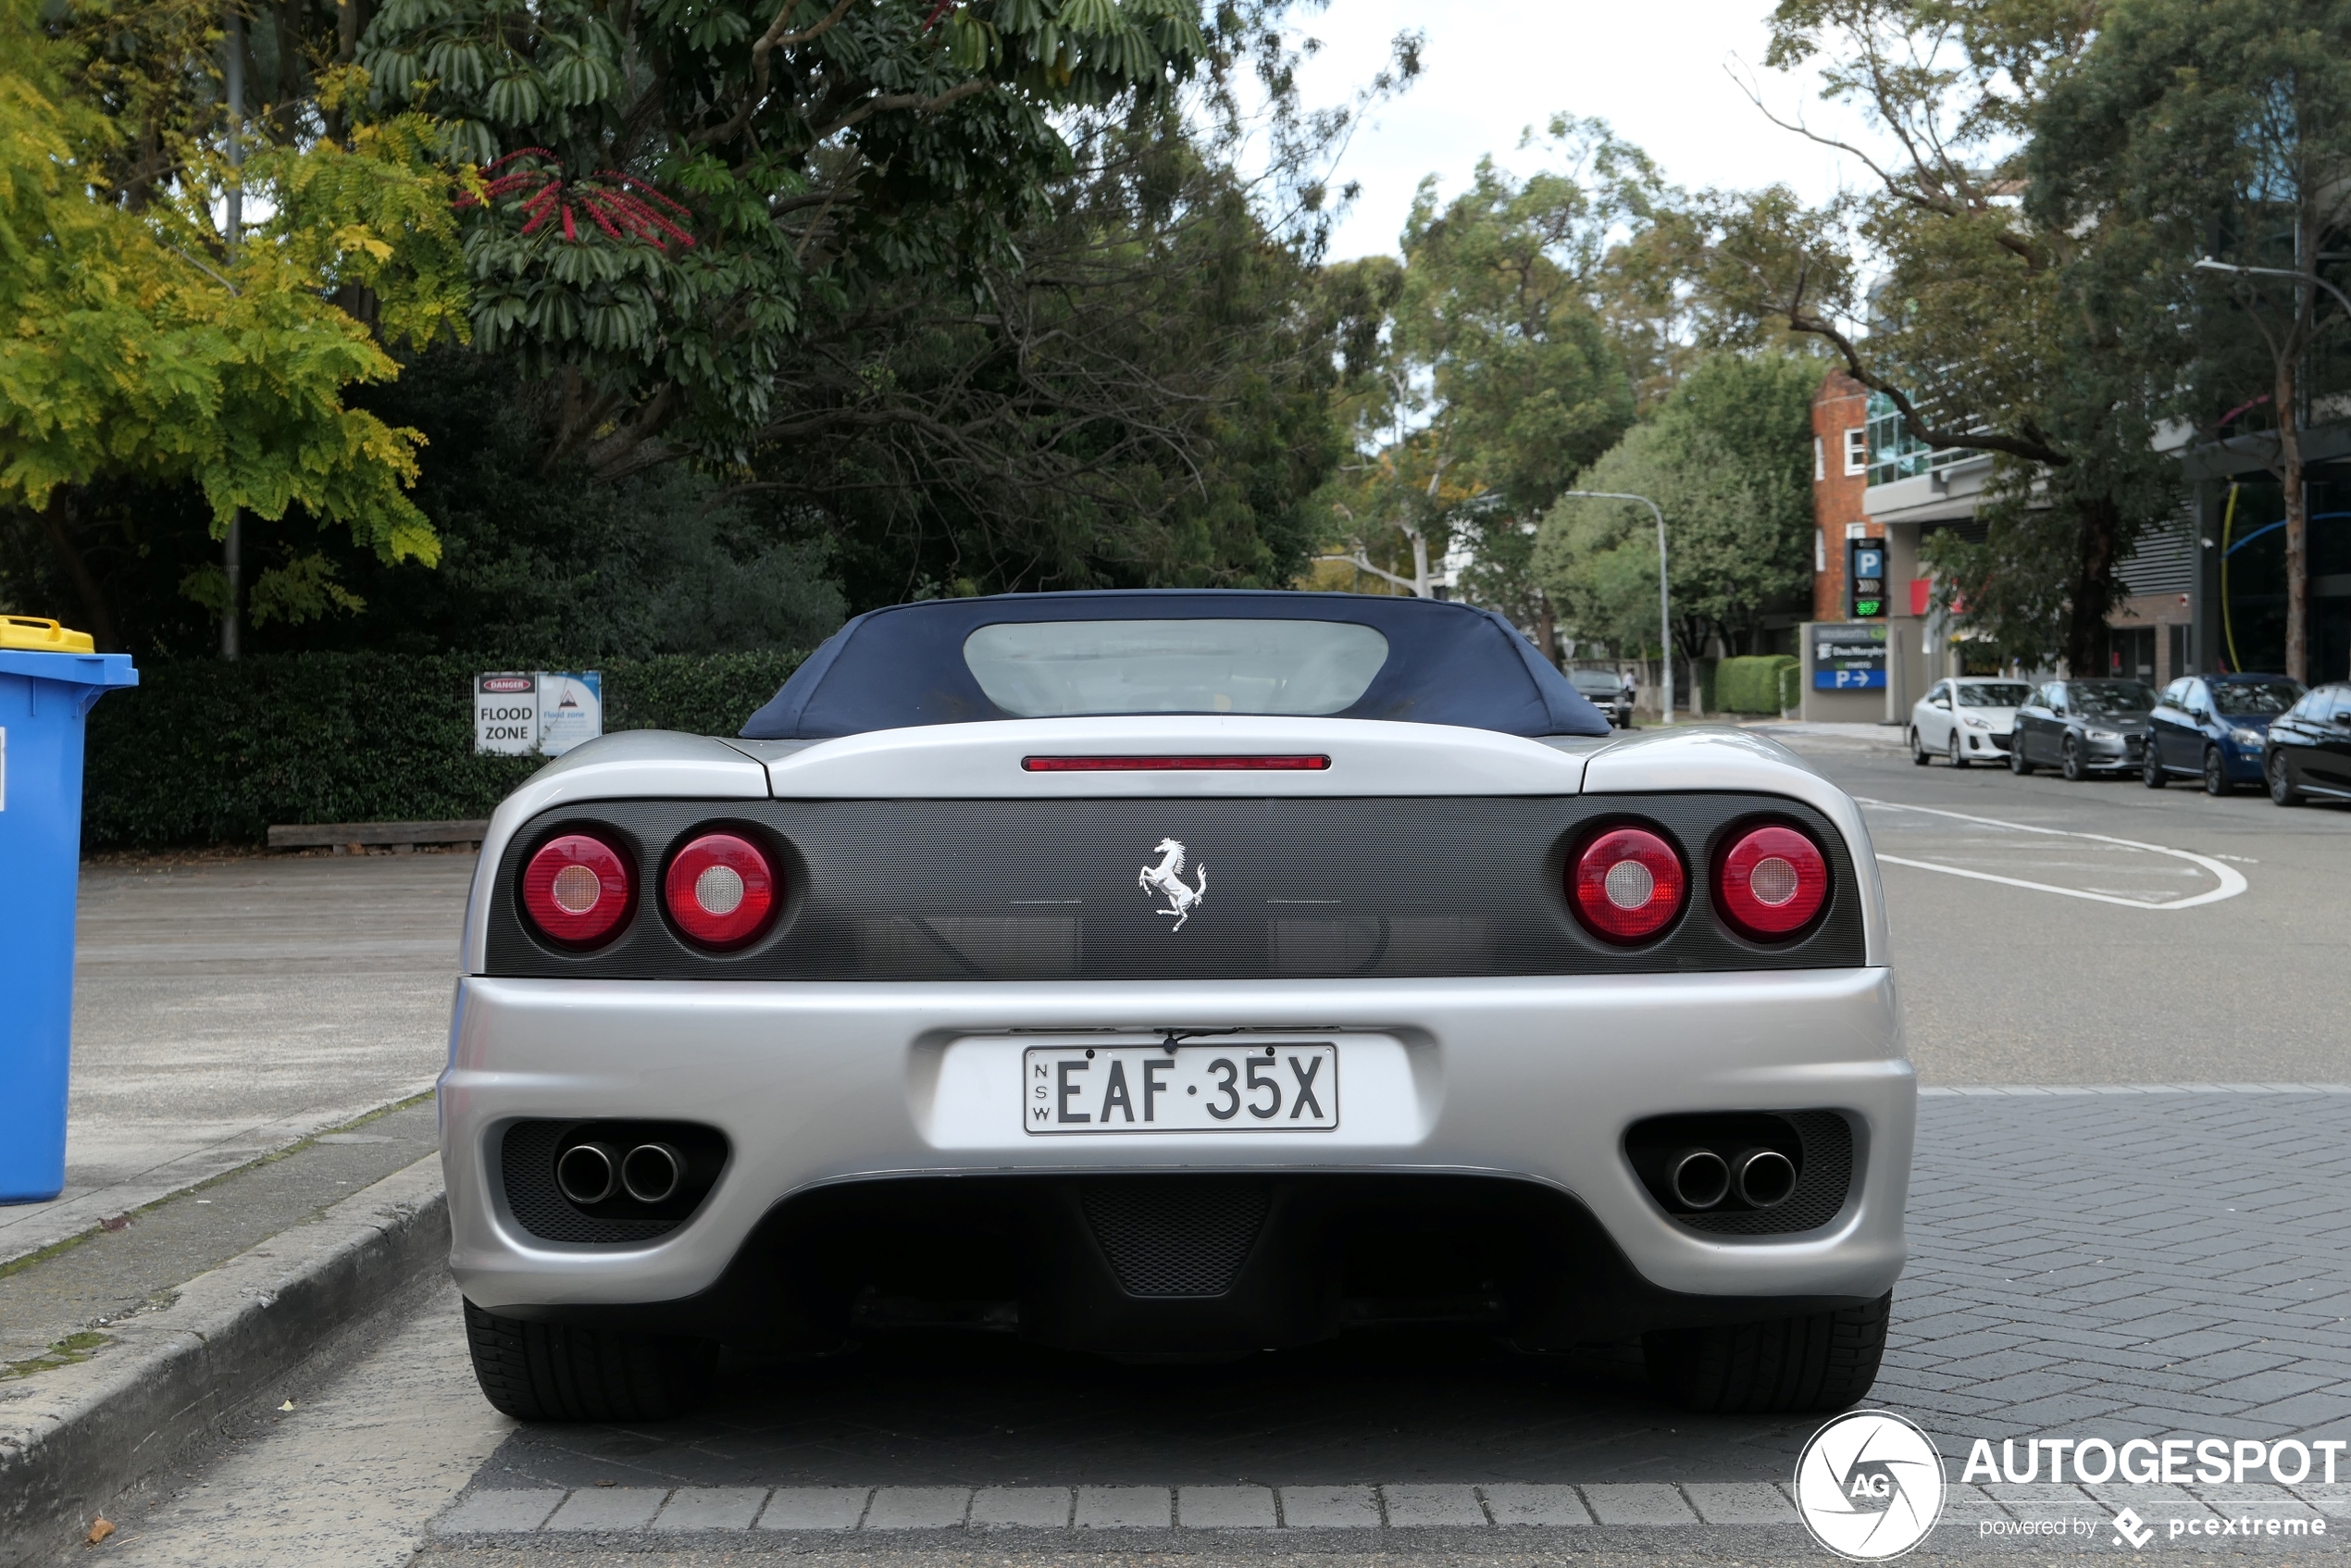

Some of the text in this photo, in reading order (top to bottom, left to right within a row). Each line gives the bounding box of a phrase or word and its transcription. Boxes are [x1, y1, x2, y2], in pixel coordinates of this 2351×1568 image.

[1860, 553, 1878, 574] P
[1836, 671, 1850, 688] P
[481, 708, 532, 720] FLOOD
[486, 727, 528, 740] ZONE
